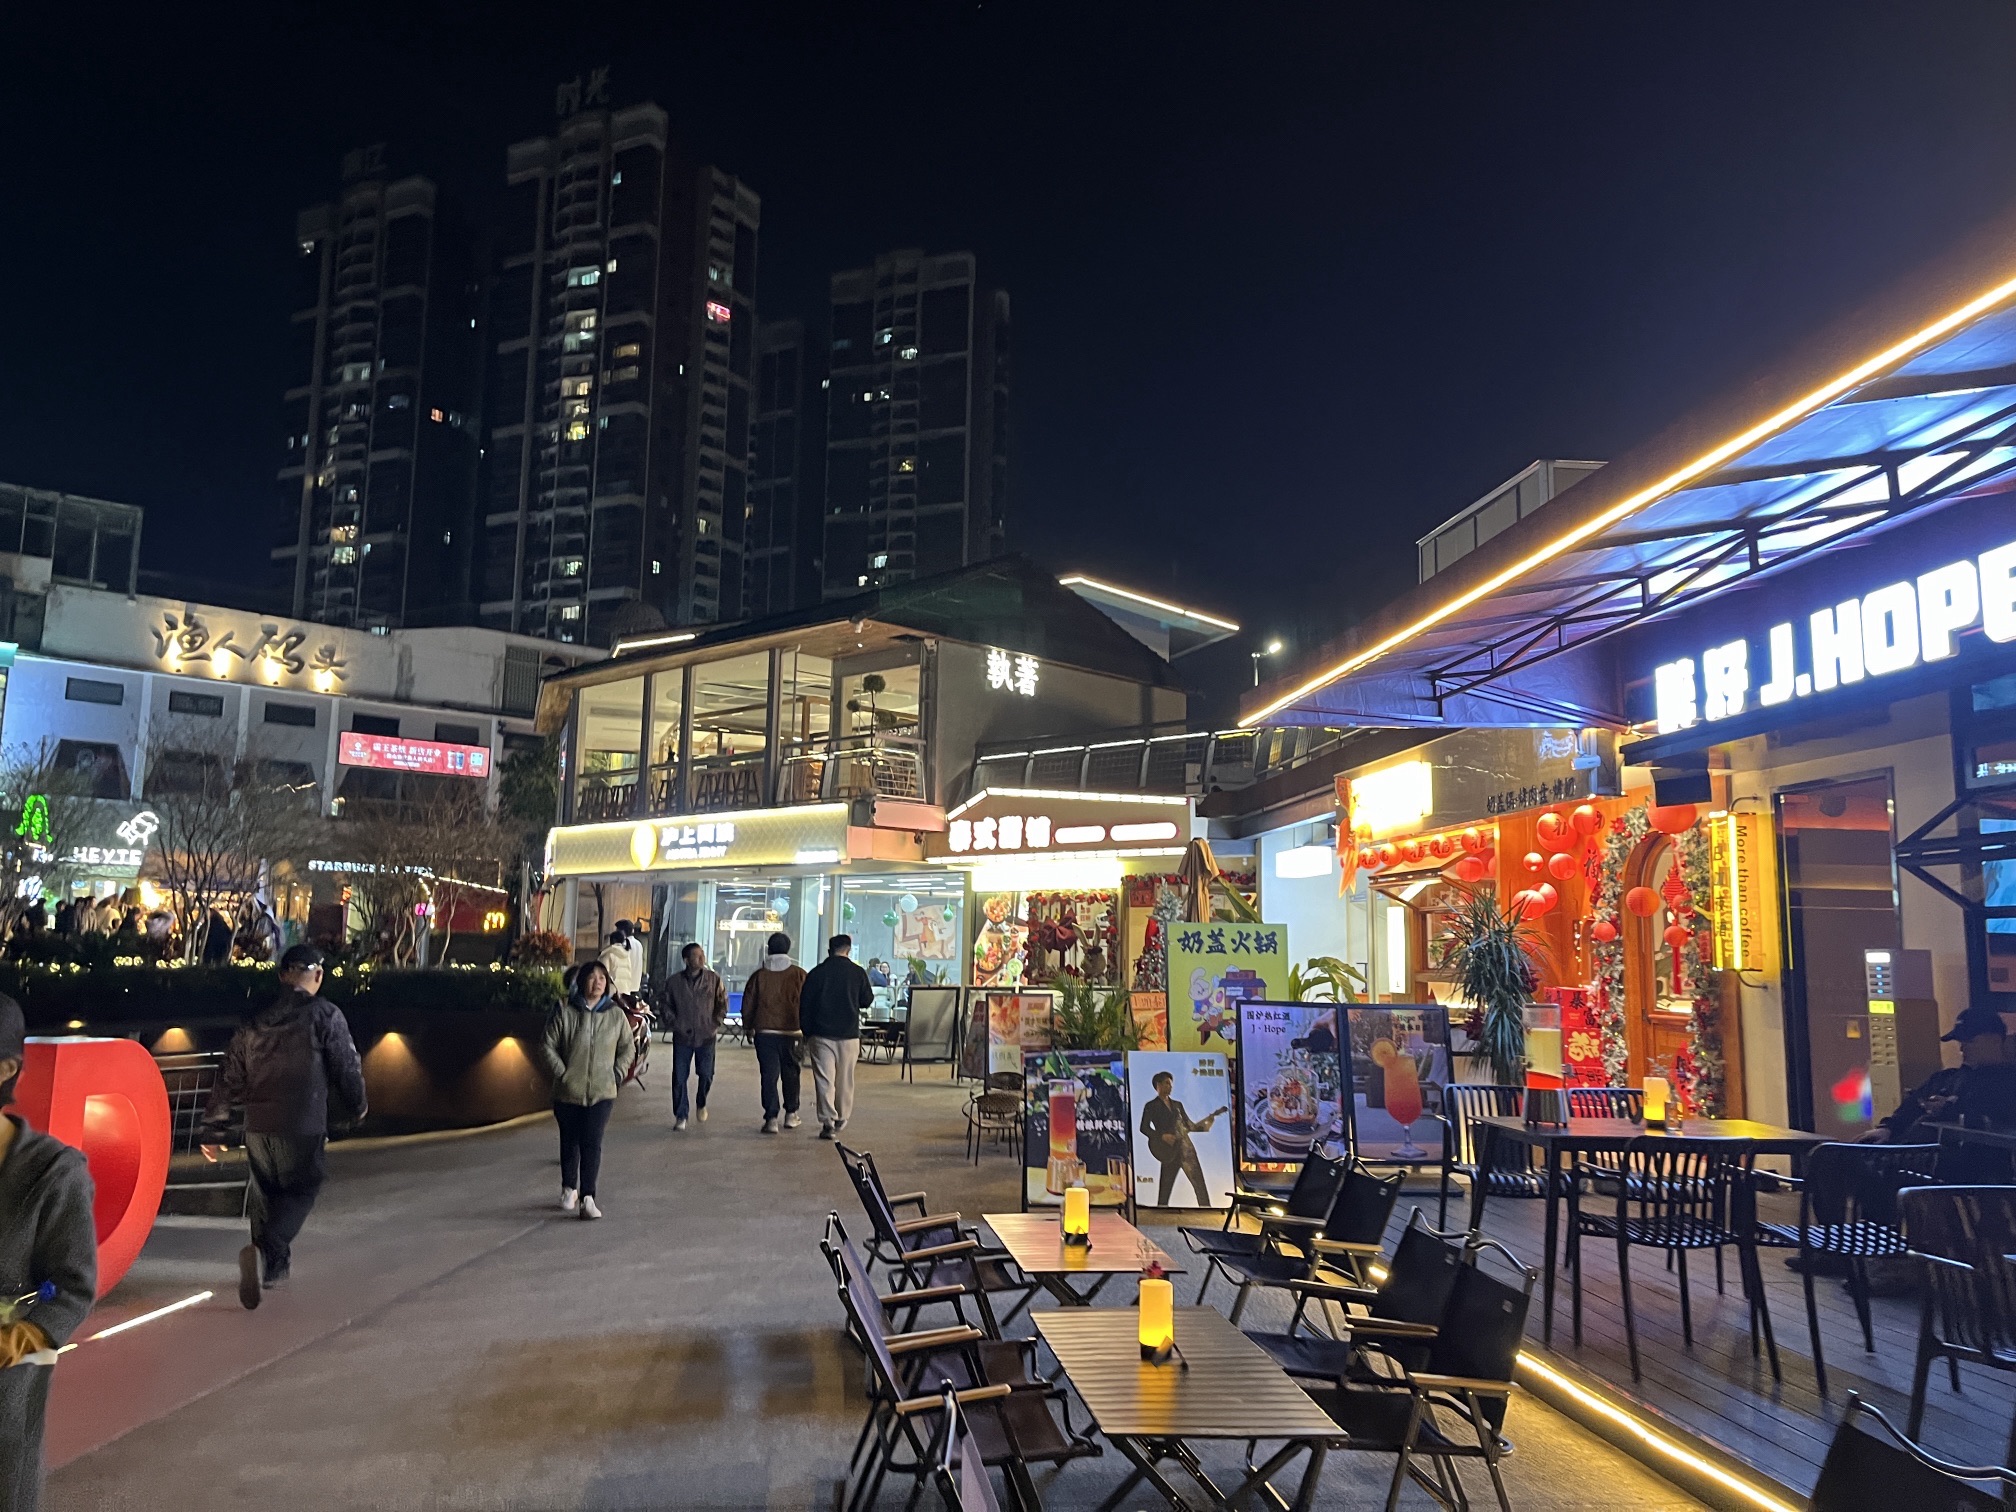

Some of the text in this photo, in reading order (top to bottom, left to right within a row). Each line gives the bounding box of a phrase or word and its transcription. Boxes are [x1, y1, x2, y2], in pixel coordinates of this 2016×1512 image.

[150, 602, 350, 681] 渔人码头
[1760, 540, 2016, 706] J.HOPE
[73, 846, 142, 866] HEYTE
[1736, 825, 1752, 957] More than coffee
[1177, 927, 1279, 956] 奶盖火锅
[1136, 1175, 1154, 1183] Ken
